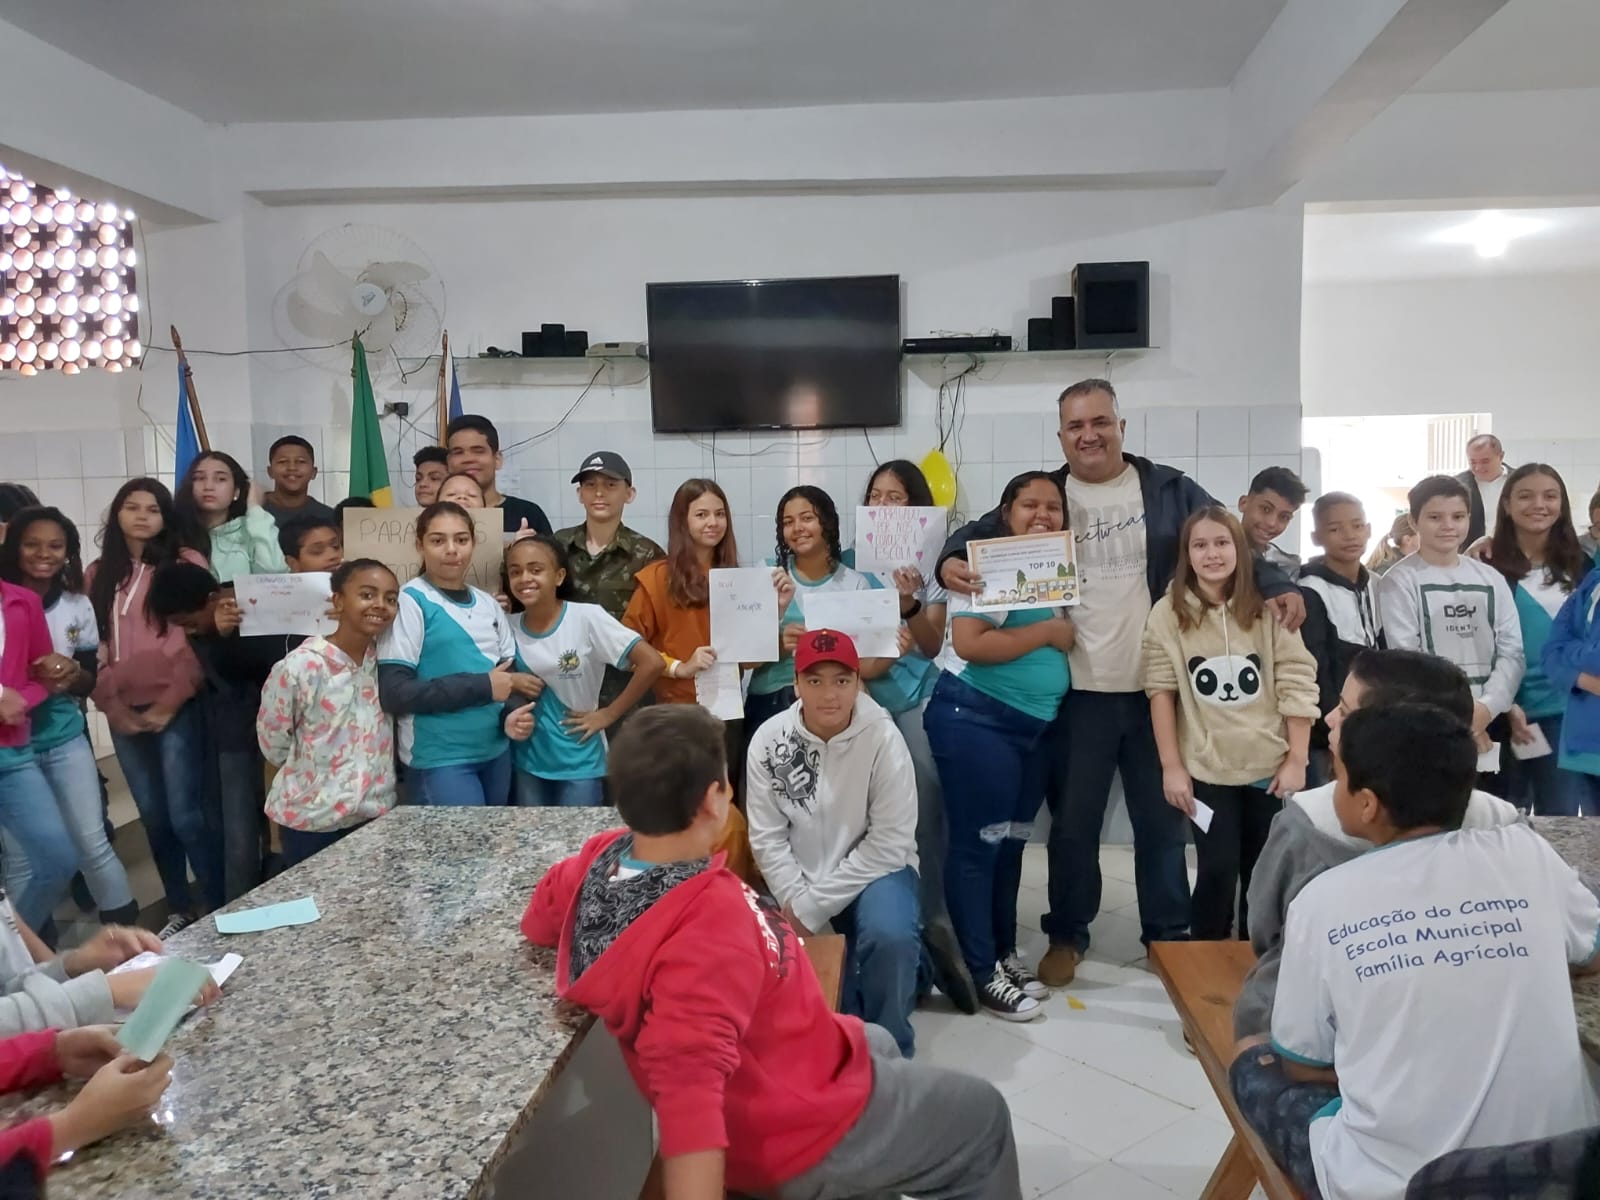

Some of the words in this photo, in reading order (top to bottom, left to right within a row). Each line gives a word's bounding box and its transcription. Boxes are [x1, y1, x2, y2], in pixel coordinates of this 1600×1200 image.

[1029, 562, 1044, 570] TOP
[1046, 560, 1056, 569] 10
[1327, 909, 1416, 945] Educação
[1424, 905, 1451, 918] do
[1459, 898, 1529, 915] Campo
[1345, 932, 1408, 960] Escola
[1415, 918, 1523, 942] Municipal
[1355, 954, 1425, 982] Família
[1433, 942, 1529, 967] Agrícola
